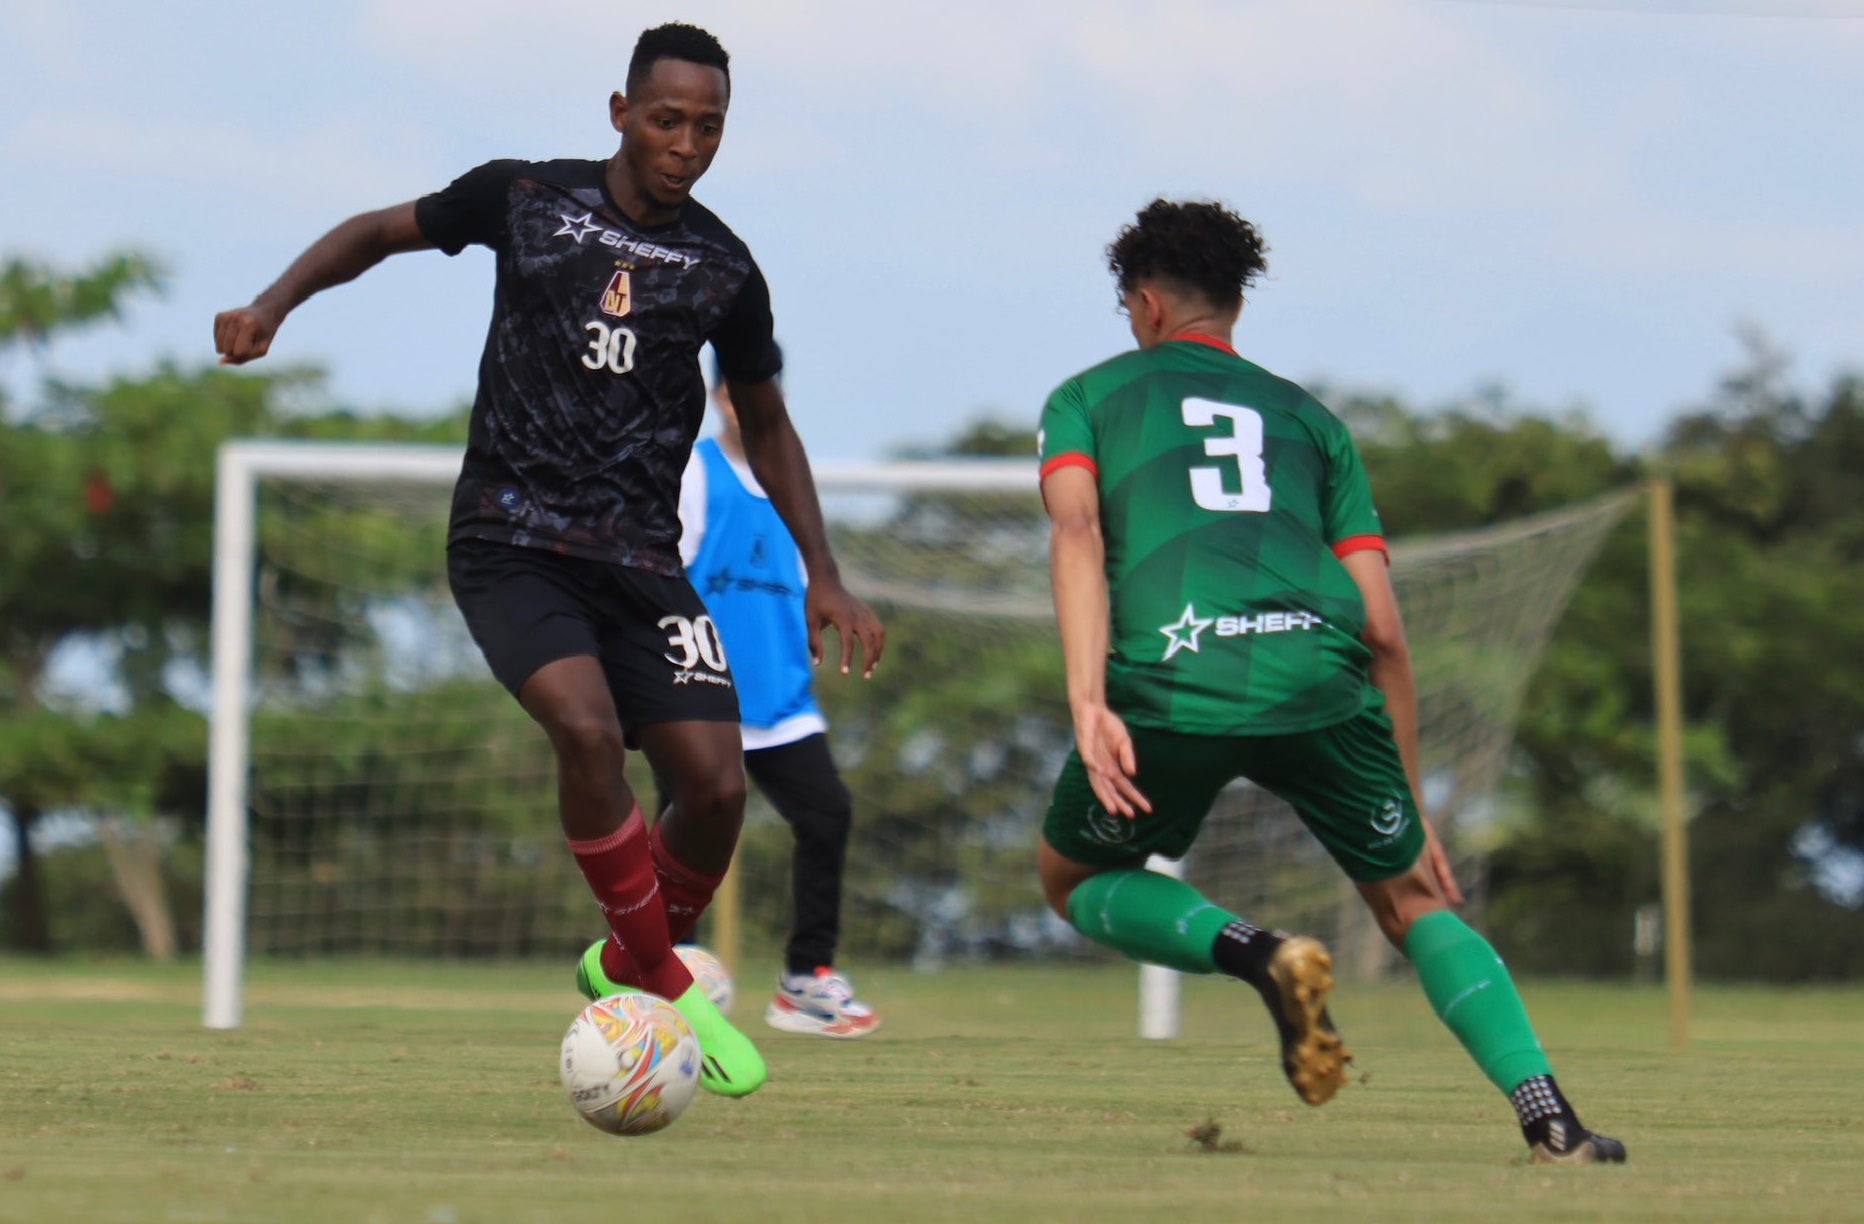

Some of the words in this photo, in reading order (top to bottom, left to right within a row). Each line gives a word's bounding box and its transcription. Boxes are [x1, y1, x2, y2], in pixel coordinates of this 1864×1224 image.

[599, 230, 699, 270] SHEFFY
[581, 321, 637, 374] 30
[1181, 397, 1272, 513] 3
[657, 614, 728, 672] 30
